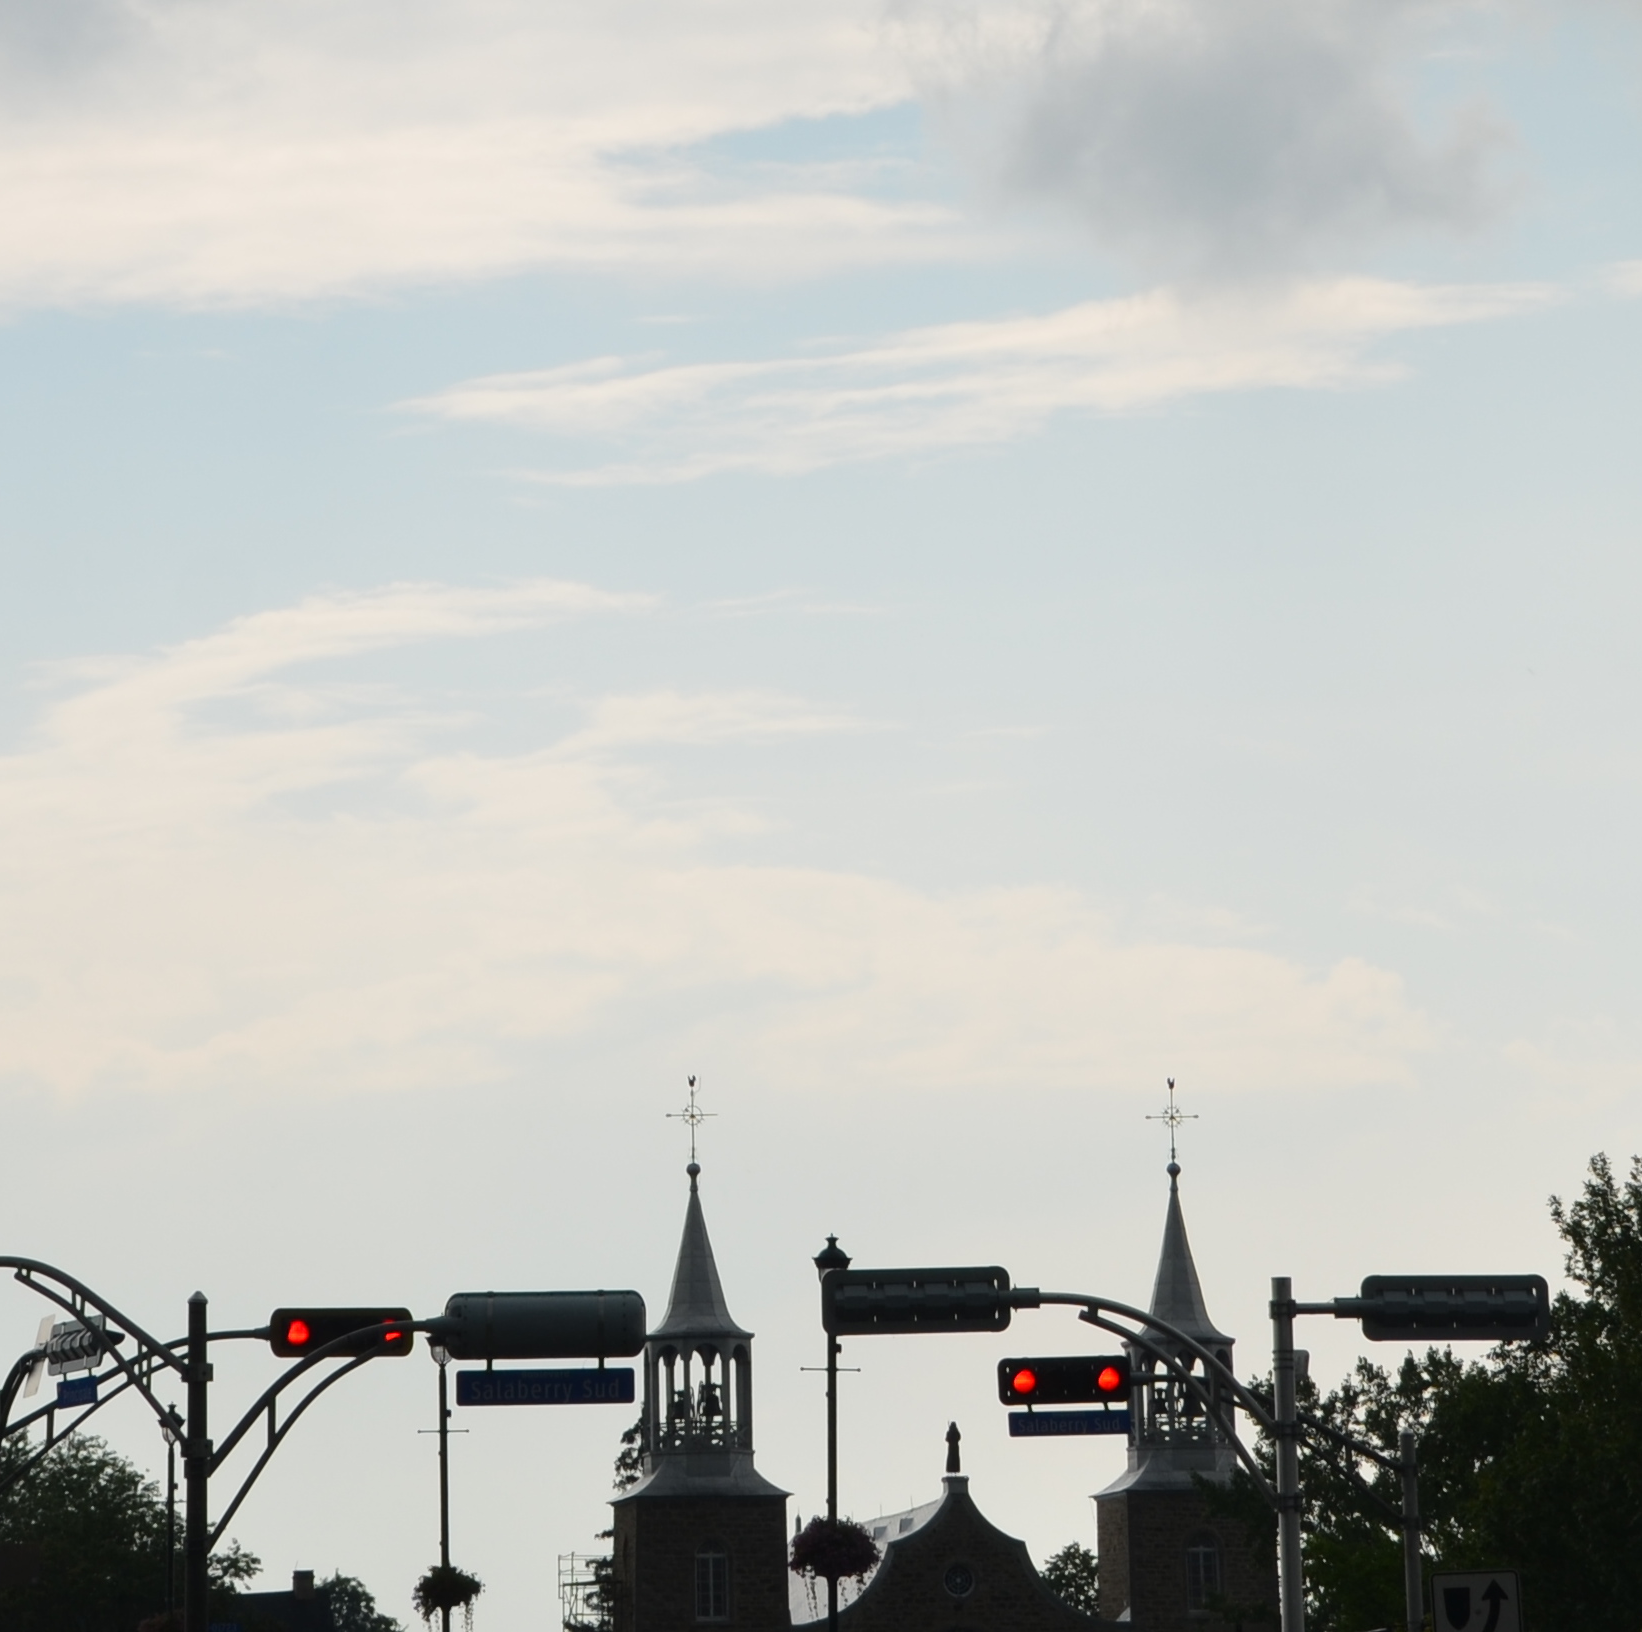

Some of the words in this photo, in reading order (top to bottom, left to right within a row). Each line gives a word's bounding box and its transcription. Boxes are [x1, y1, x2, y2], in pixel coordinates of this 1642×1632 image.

[470, 1378, 574, 1404] Salaberry
[583, 1377, 621, 1399] Sud
[1018, 1417, 1088, 1434] Salaberry
[1094, 1416, 1121, 1432] Sud
